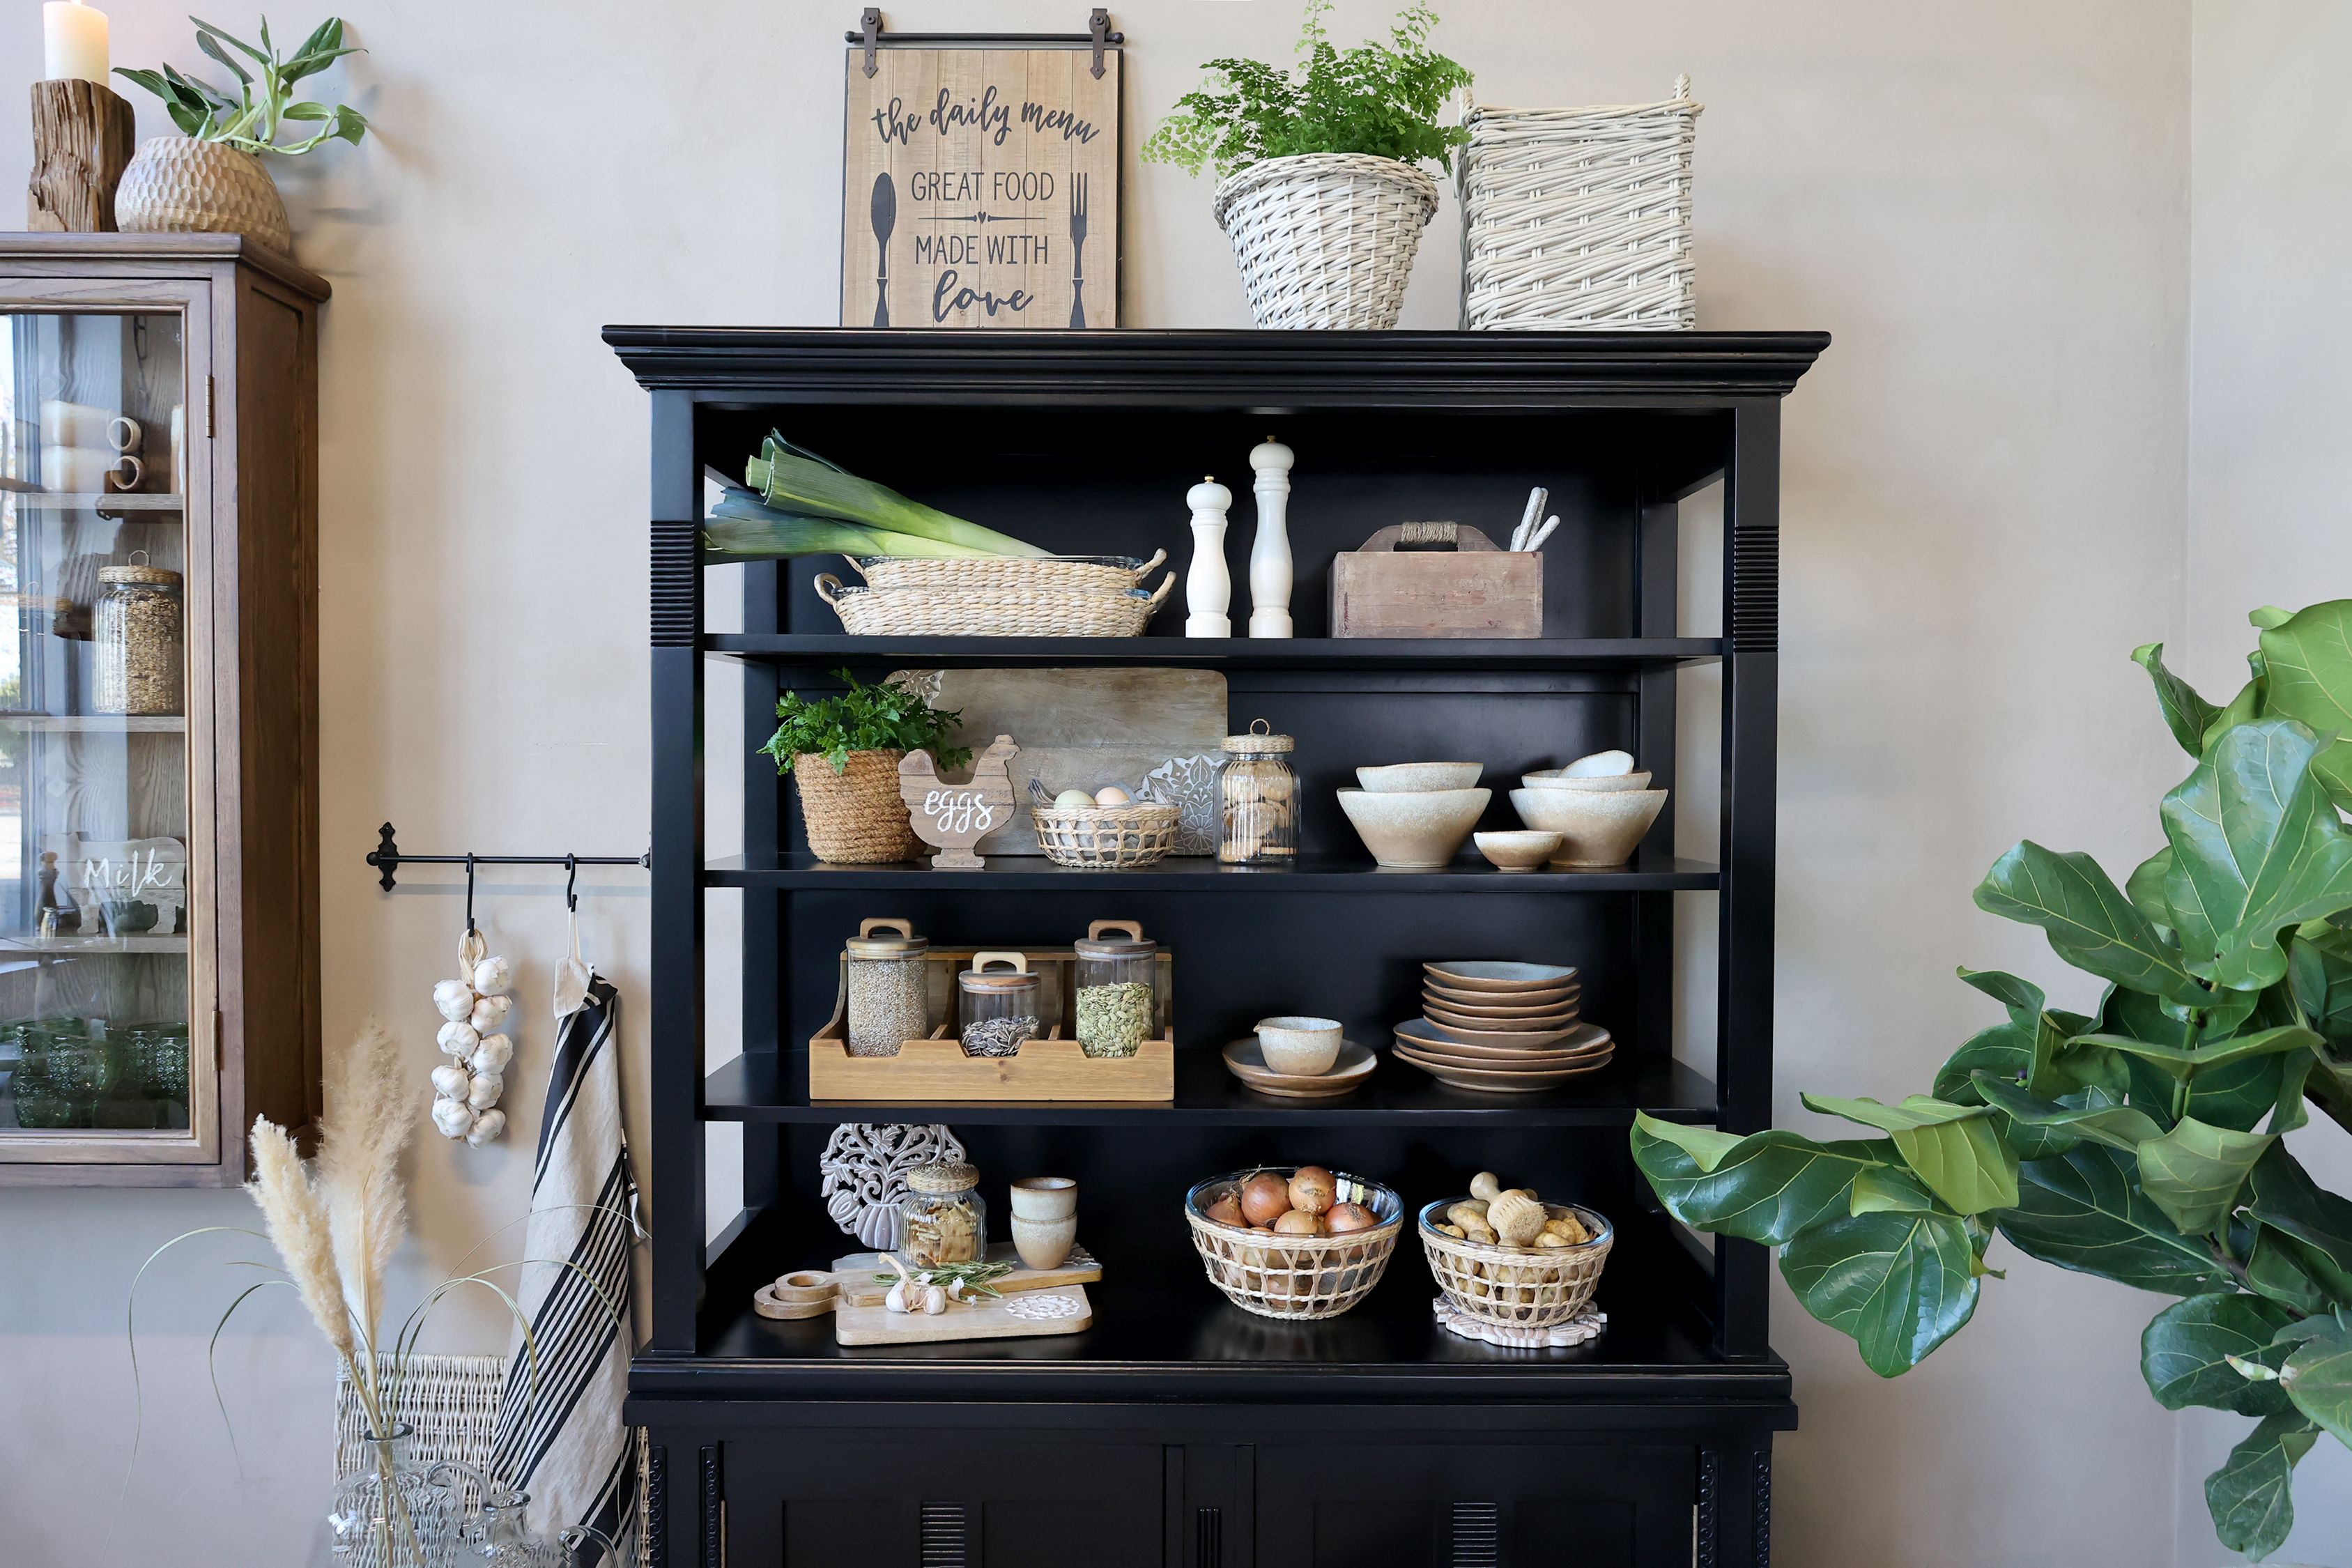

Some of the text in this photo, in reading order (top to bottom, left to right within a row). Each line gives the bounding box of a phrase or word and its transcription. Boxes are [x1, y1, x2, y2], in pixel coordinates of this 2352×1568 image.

[871, 86, 1100, 146] the daily menu
[911, 171, 1054, 201] GREAT FOOD
[916, 236, 1048, 265] MADE WITH
[934, 270, 1033, 323] love
[923, 790, 994, 833] eggs
[84, 847, 172, 898] Milk
